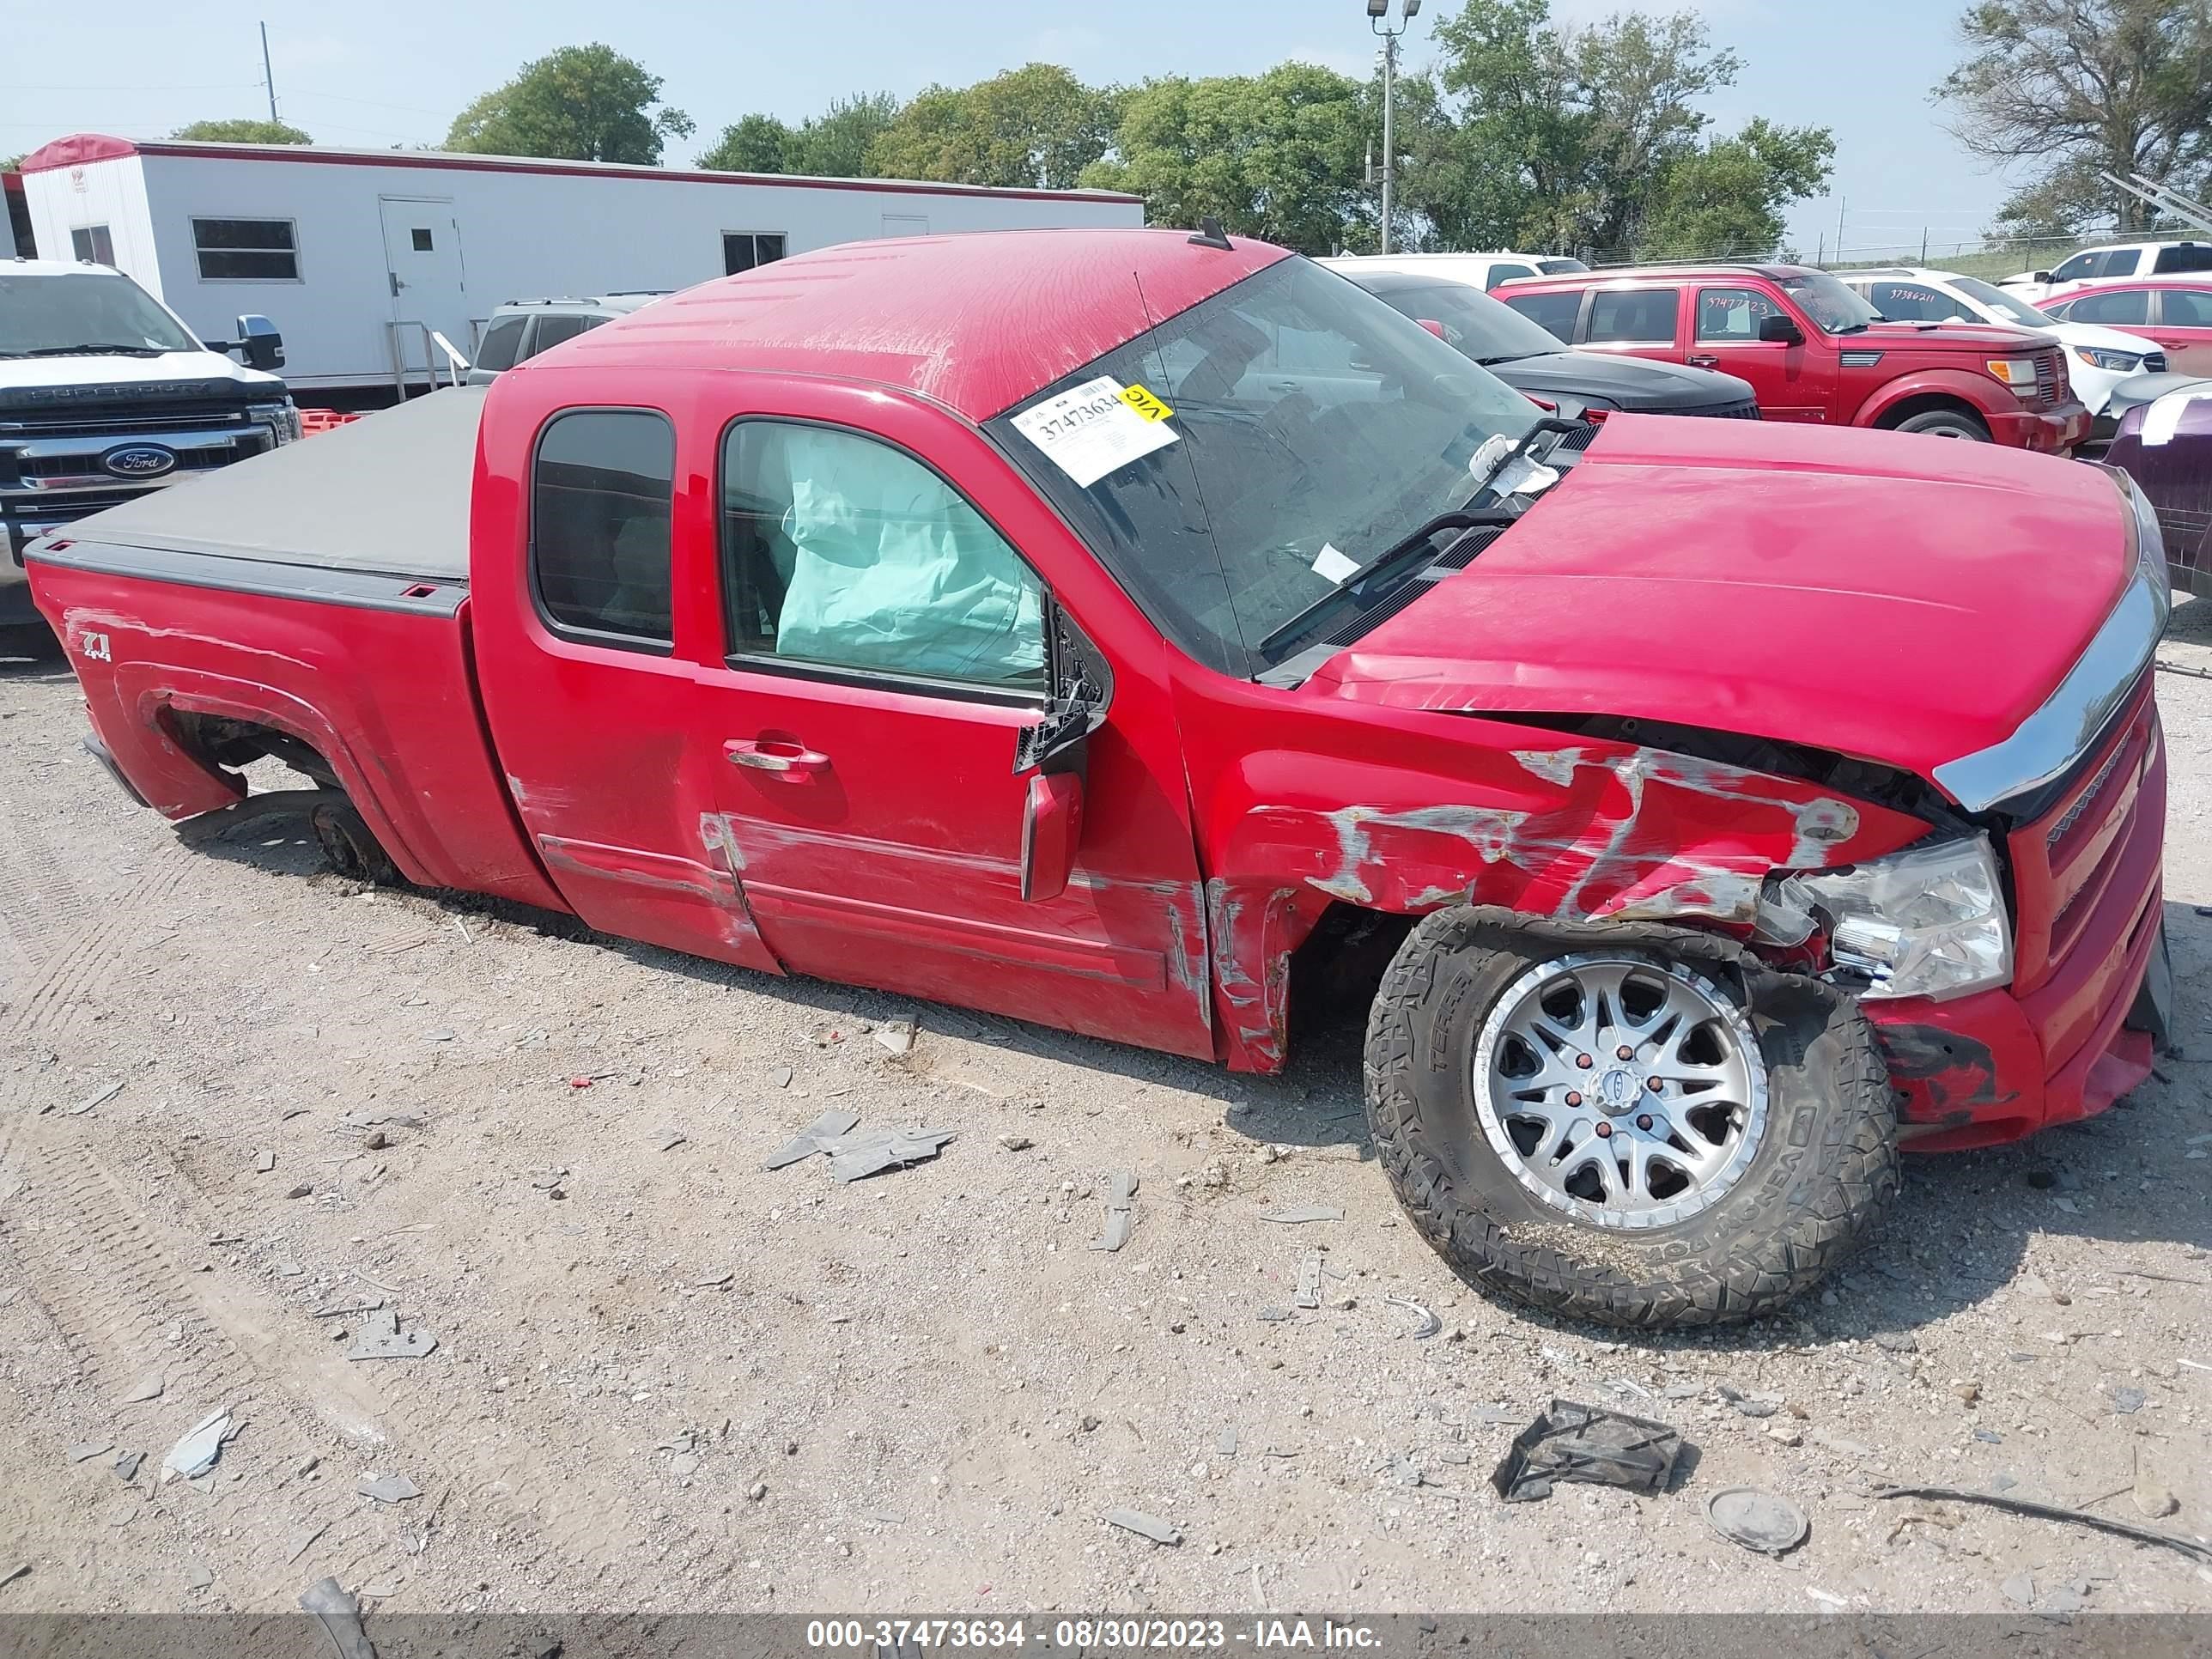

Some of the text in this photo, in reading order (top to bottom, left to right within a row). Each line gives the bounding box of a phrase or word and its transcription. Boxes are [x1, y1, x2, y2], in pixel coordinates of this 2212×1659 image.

[1889, 289, 1936, 303] 37386211
[1125, 389, 1161, 420] VIC
[1038, 393, 1124, 441] 37473634
[123, 453, 159, 469] Ford
